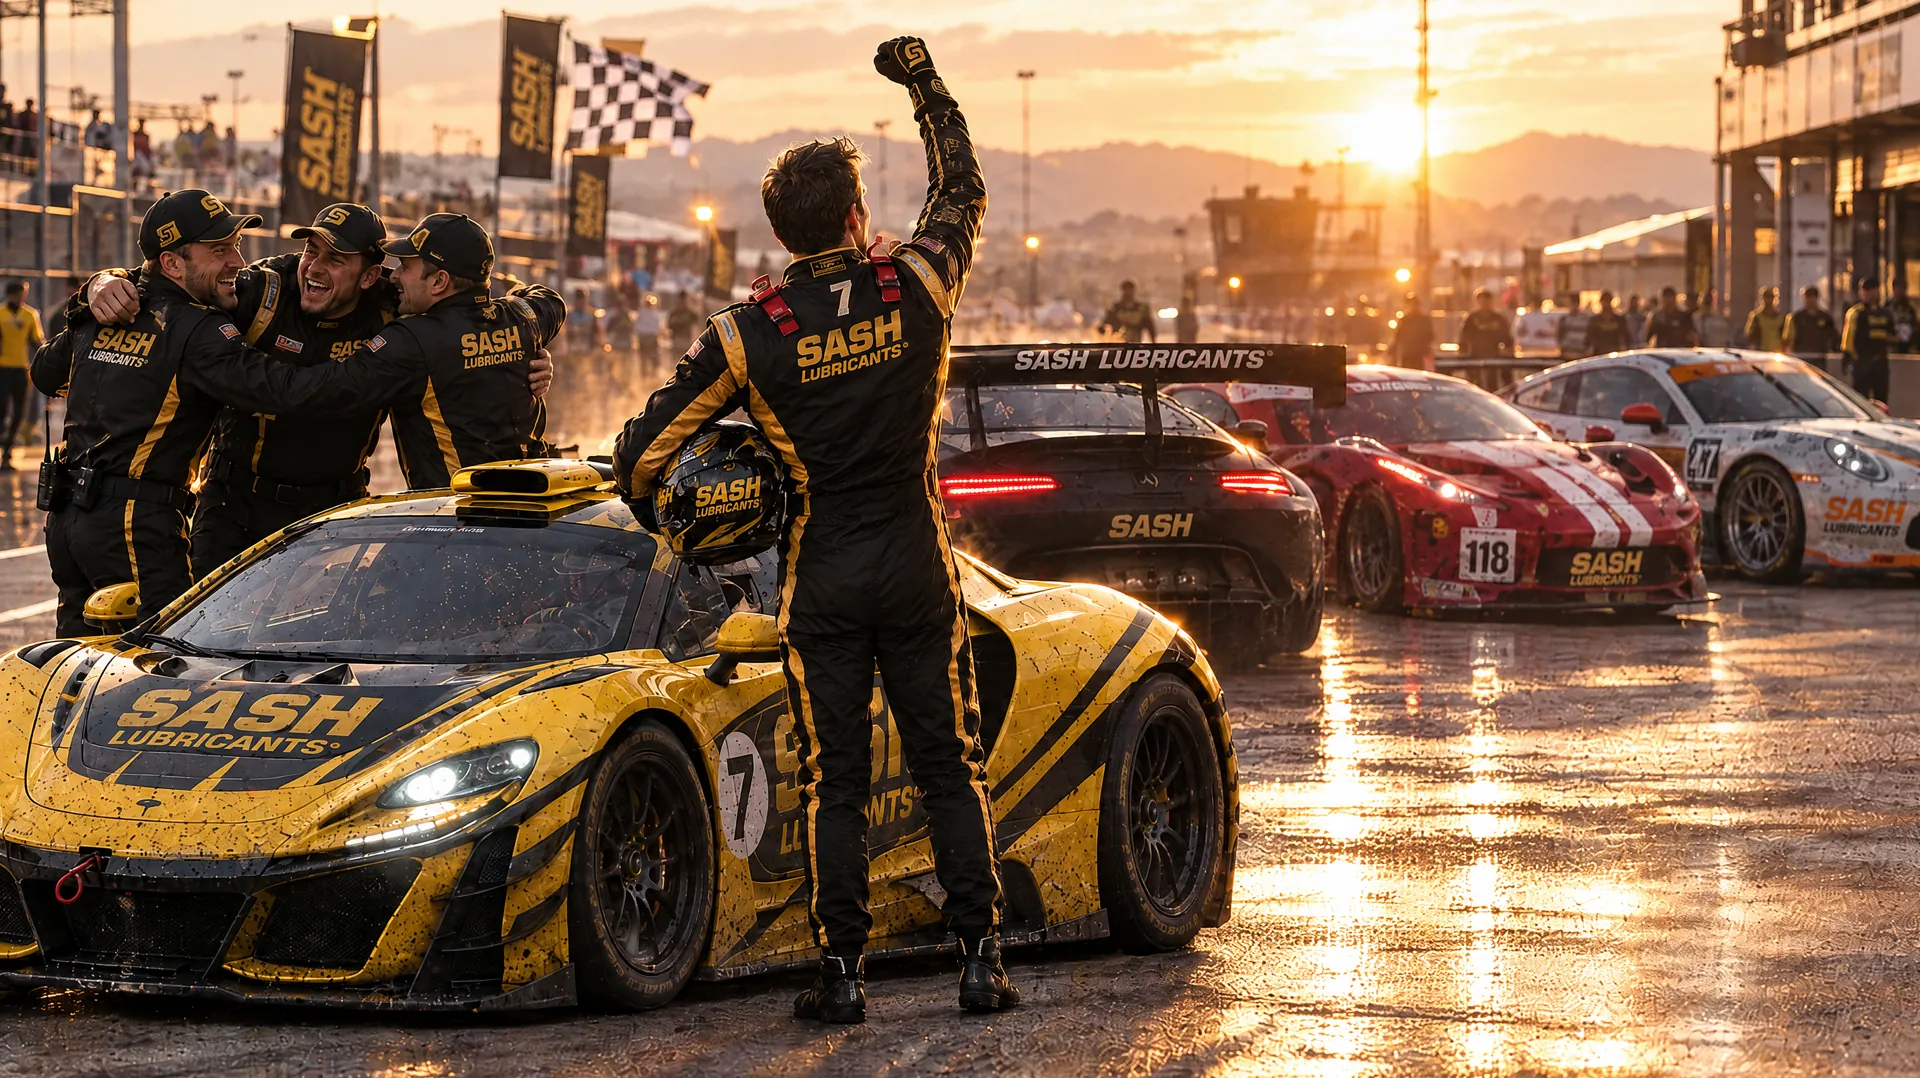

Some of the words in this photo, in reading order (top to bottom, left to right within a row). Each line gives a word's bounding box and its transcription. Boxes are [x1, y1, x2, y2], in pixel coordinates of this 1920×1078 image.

[509, 44, 539, 150] SASH
[298, 65, 340, 196] SASH
[830, 279, 852, 317] 7
[93, 327, 157, 356] SASH
[461, 326, 522, 357] SASH
[797, 309, 902, 367] SASH
[1014, 349, 1089, 371] SASH
[695, 476, 761, 507] SASH
[1108, 513, 1194, 538] SASH
[1824, 496, 1907, 524] SASH
[1823, 522, 1900, 537] LUBRICANTS
[1465, 540, 1509, 574] 118
[1570, 550, 1643, 575] SASH
[116, 688, 383, 737] SASH
[727, 753, 754, 841] 7
